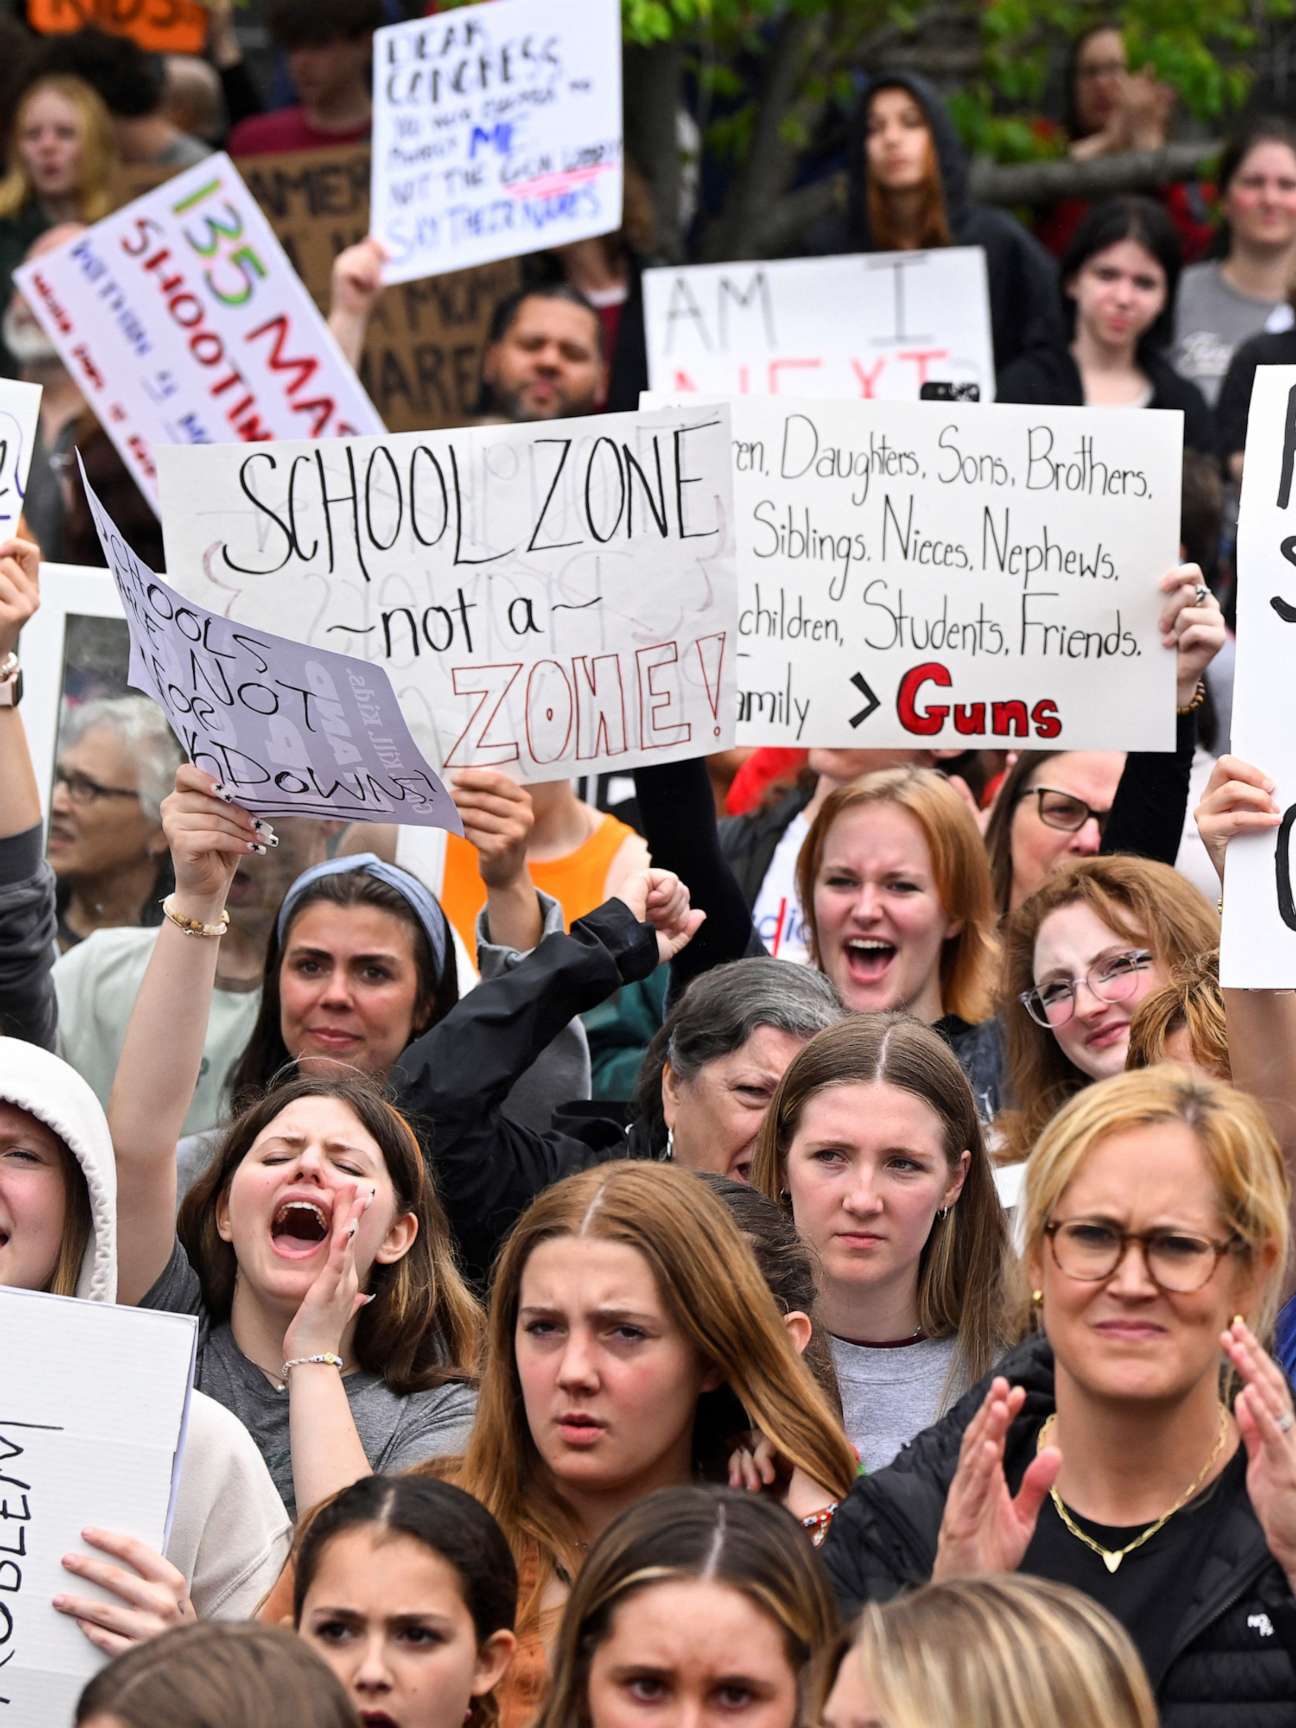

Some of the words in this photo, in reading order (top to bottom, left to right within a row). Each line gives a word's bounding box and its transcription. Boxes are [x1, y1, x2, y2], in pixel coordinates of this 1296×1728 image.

[172, 178, 270, 308] 135
[222, 440, 516, 582] SCHOOL
[526, 420, 724, 554] ZONE
[189, 647, 317, 734] NOT
[896, 661, 1063, 740] Guns
